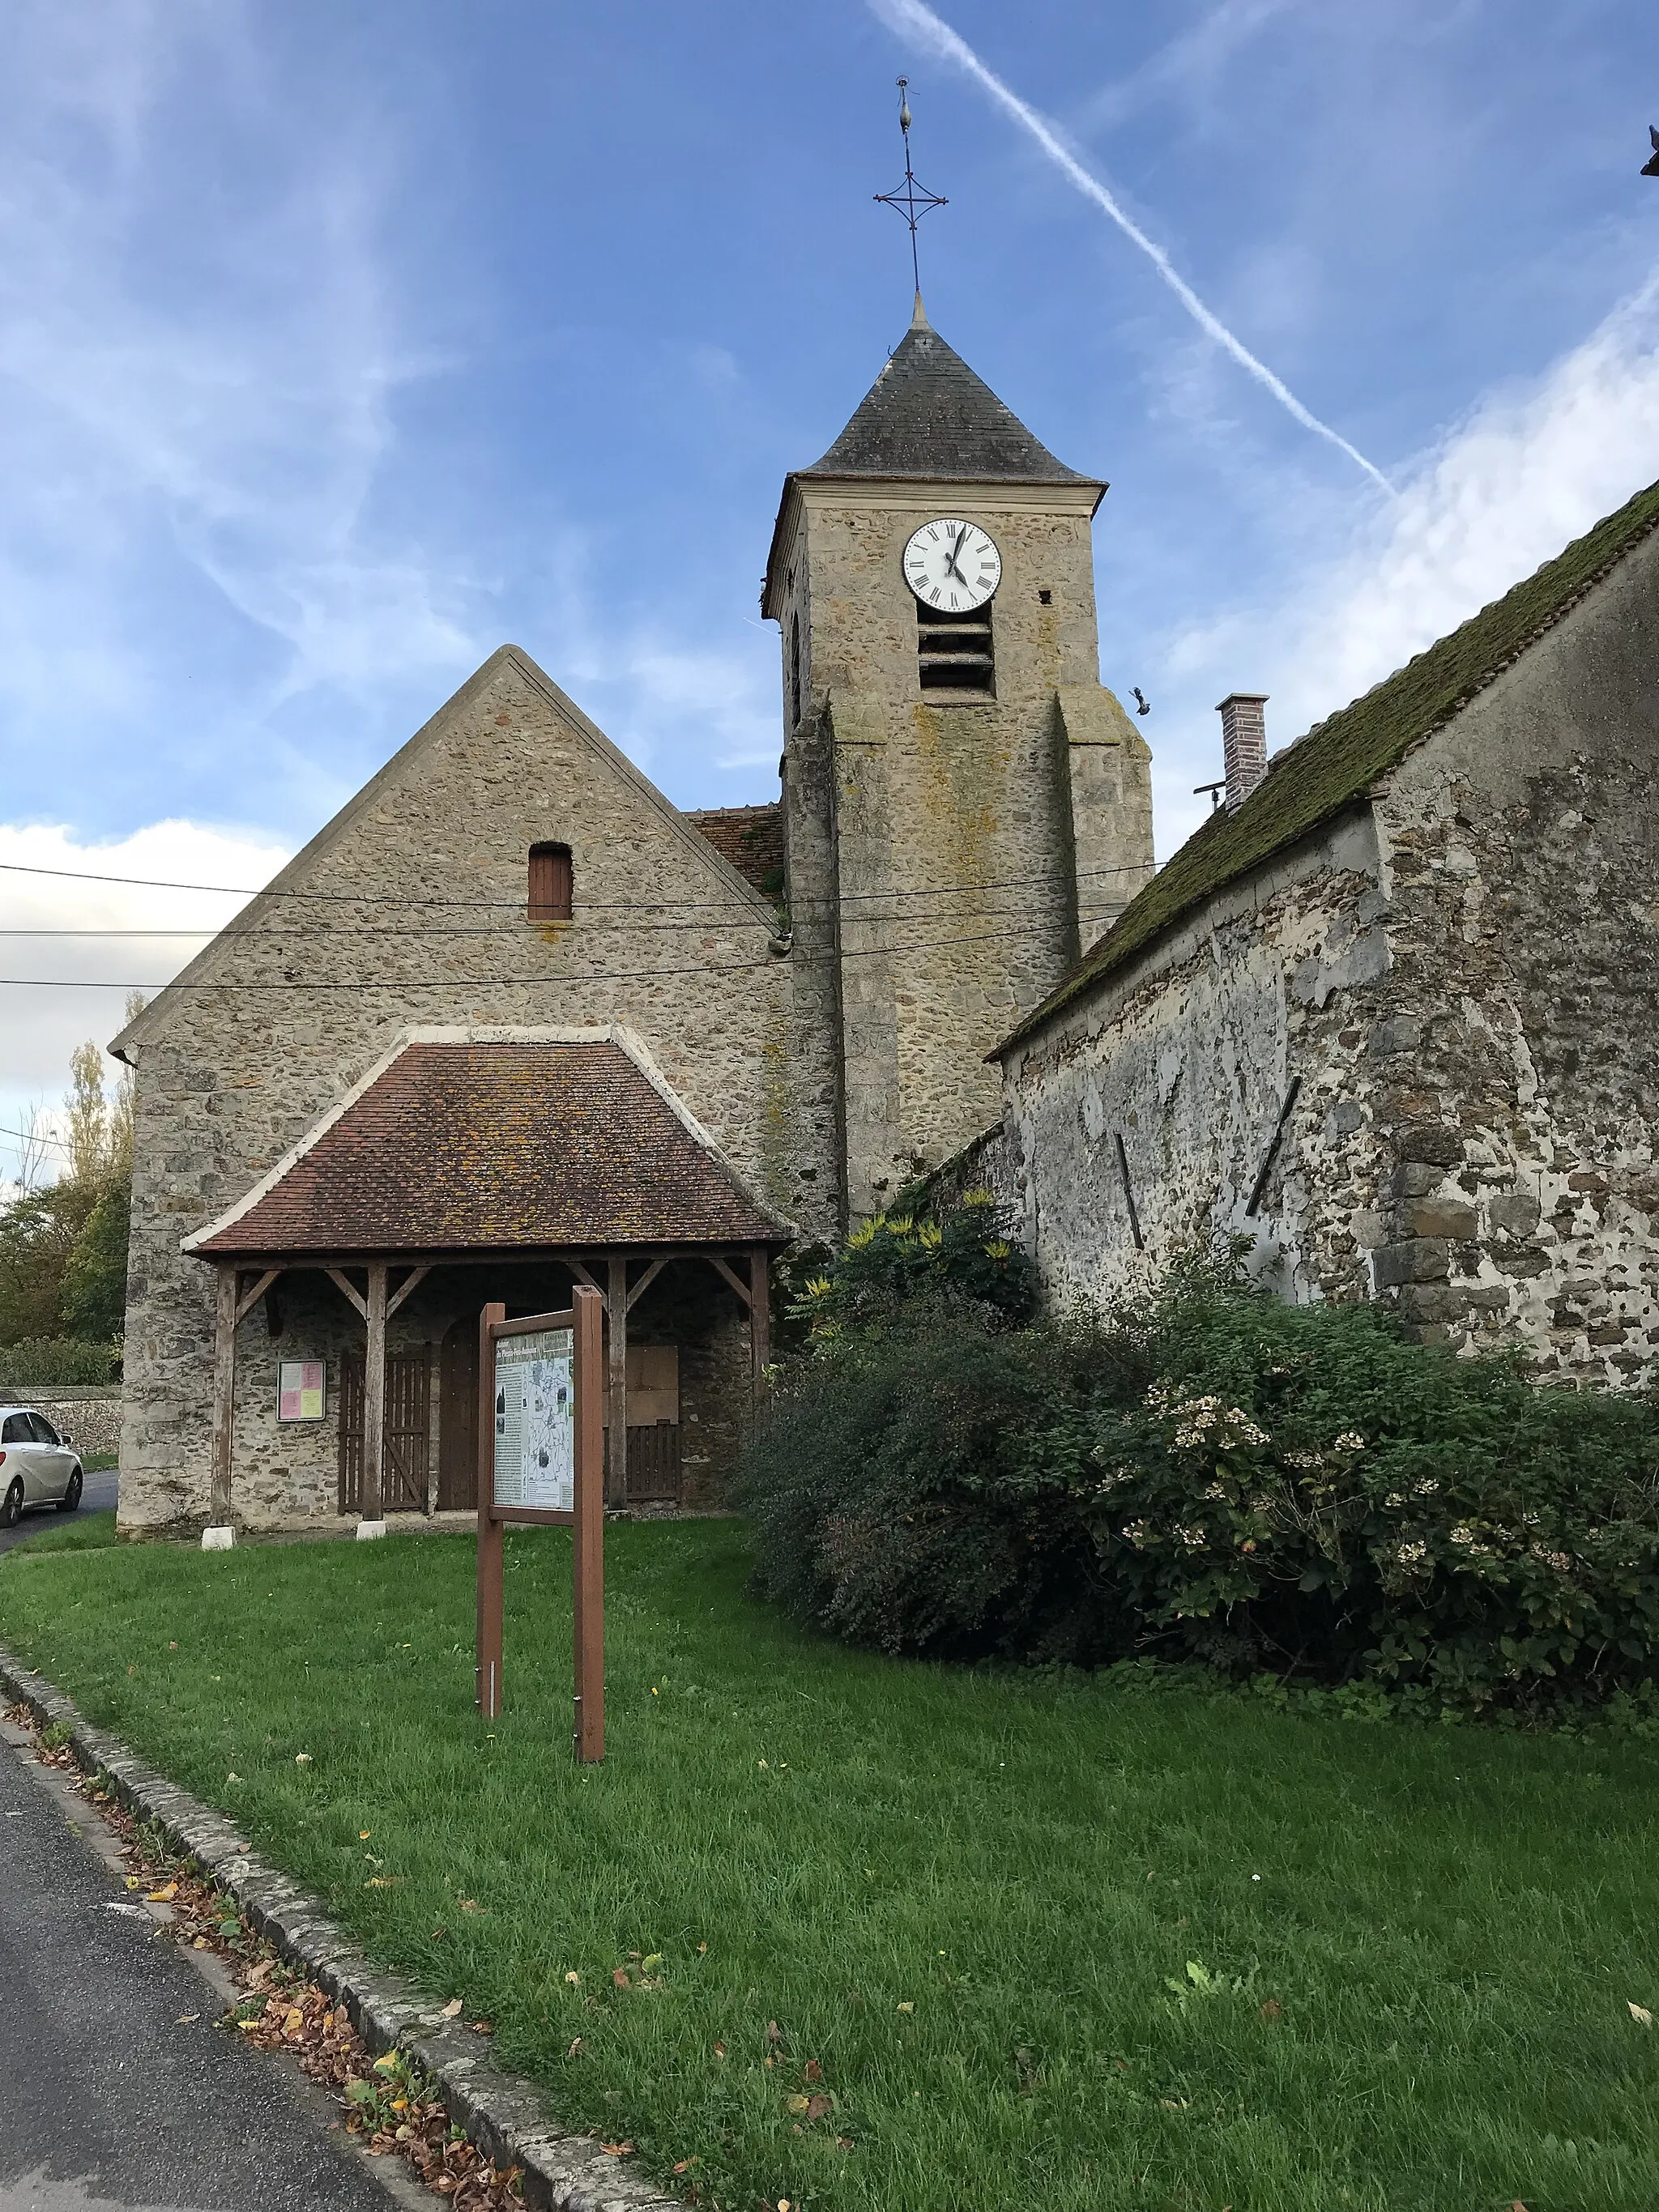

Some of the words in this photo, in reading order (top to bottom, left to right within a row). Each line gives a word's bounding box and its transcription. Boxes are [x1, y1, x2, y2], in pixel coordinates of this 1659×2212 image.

[927, 527, 940, 543] XI
[945, 524, 956, 539] XII
[913, 542, 928, 554] X
[975, 543, 990, 554] II
[914, 574, 931, 590] VIII
[975, 575, 993, 590] IIII
[928, 586, 942, 603] VII
[950, 592, 958, 607] VI
